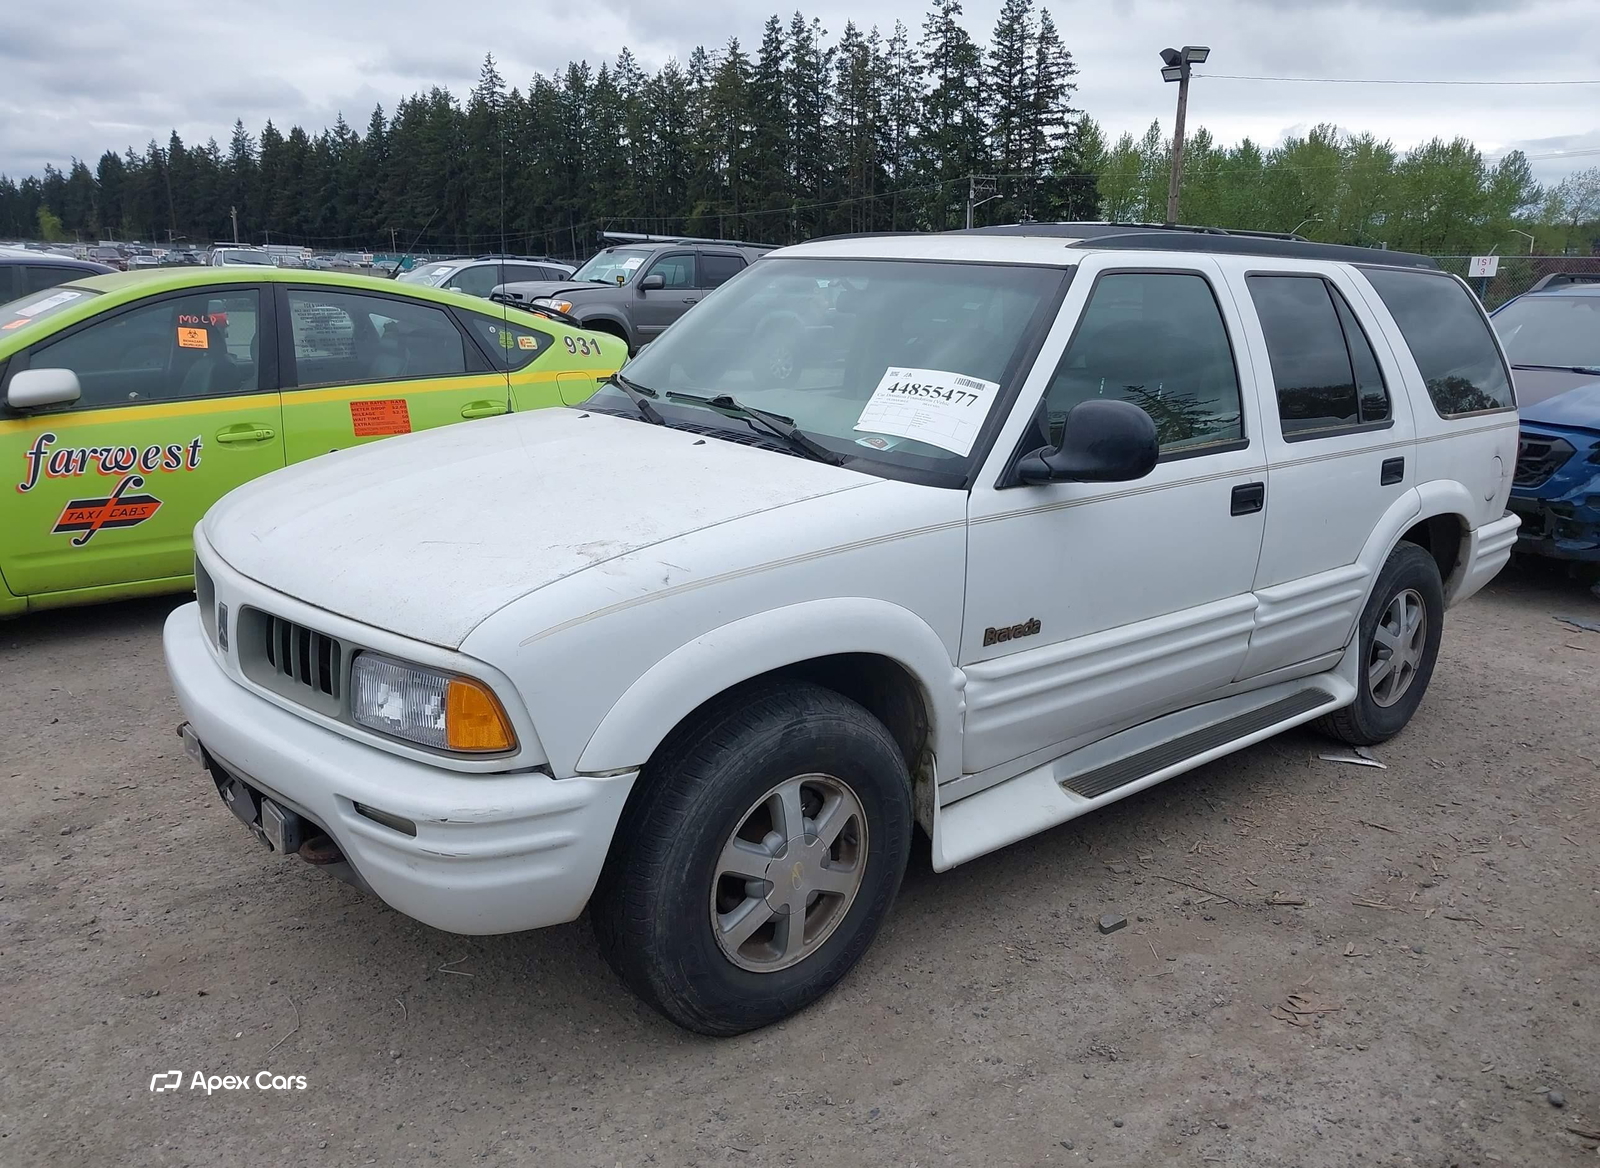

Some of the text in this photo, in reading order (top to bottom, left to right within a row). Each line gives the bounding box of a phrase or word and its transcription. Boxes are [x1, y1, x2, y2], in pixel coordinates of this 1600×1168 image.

[564, 335, 602, 357] 931
[887, 381, 979, 407] 44855477
[16, 432, 203, 493] farwest
[68, 506, 149, 522] TAXI CABS
[983, 617, 1042, 647] Bravada
